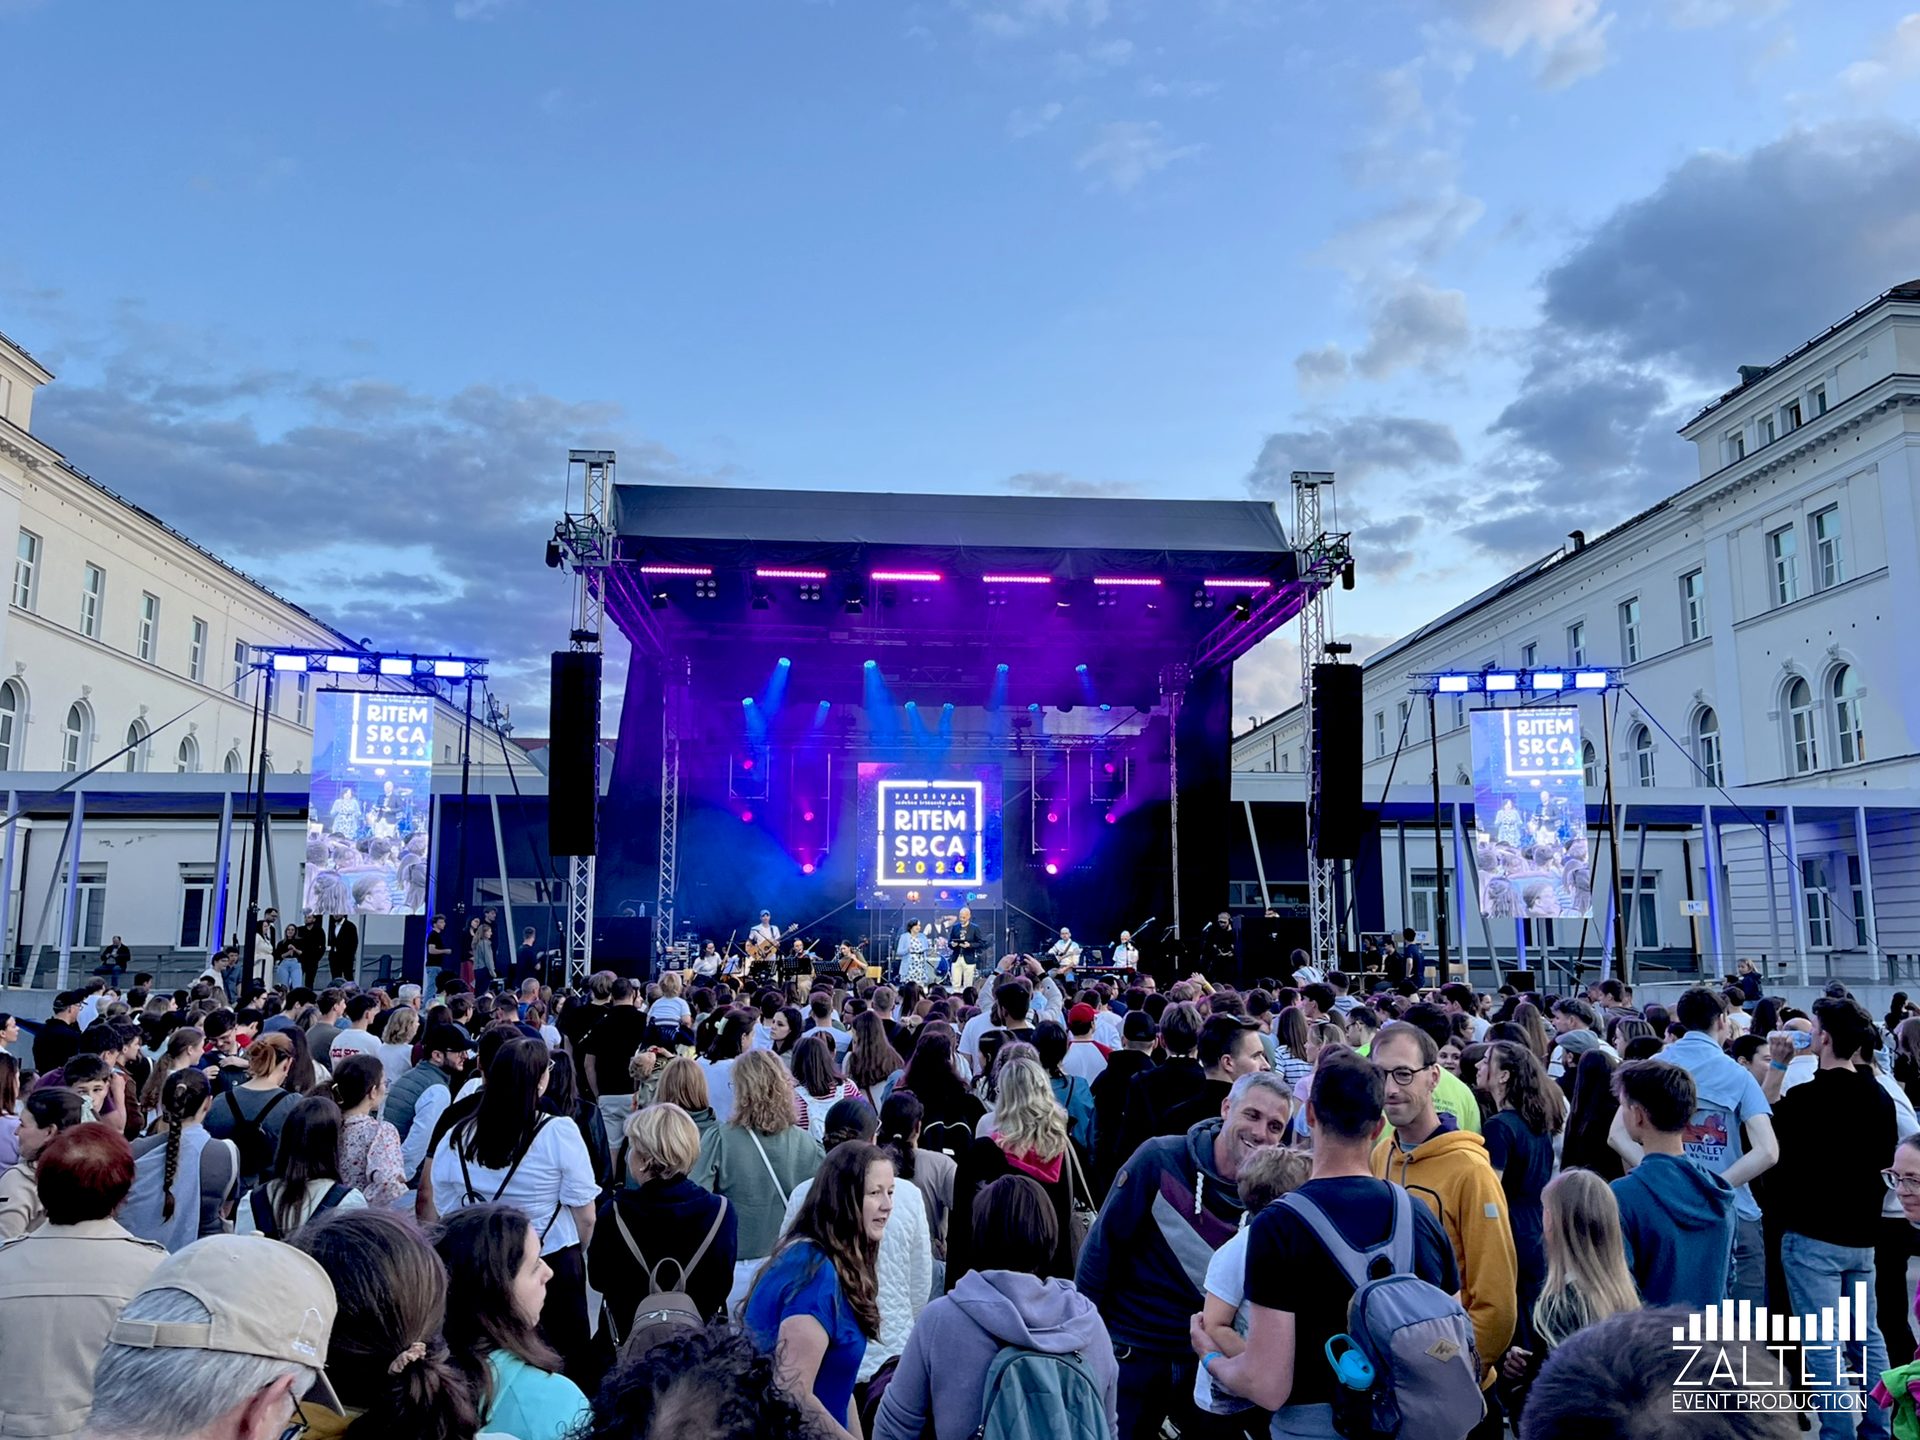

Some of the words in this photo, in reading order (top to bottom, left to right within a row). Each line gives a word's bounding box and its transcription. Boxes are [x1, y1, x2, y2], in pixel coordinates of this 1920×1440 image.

[366, 704, 428, 724] RITEM
[366, 724, 426, 743] SRCA
[1516, 718, 1574, 736] RITEM
[366, 745, 425, 756] 2026
[1518, 738, 1575, 755] SRCA
[895, 793, 966, 801] FESTIVAL
[894, 809, 966, 831] RITEM
[894, 835, 966, 857] SRCA
[895, 861, 965, 874] 2026
